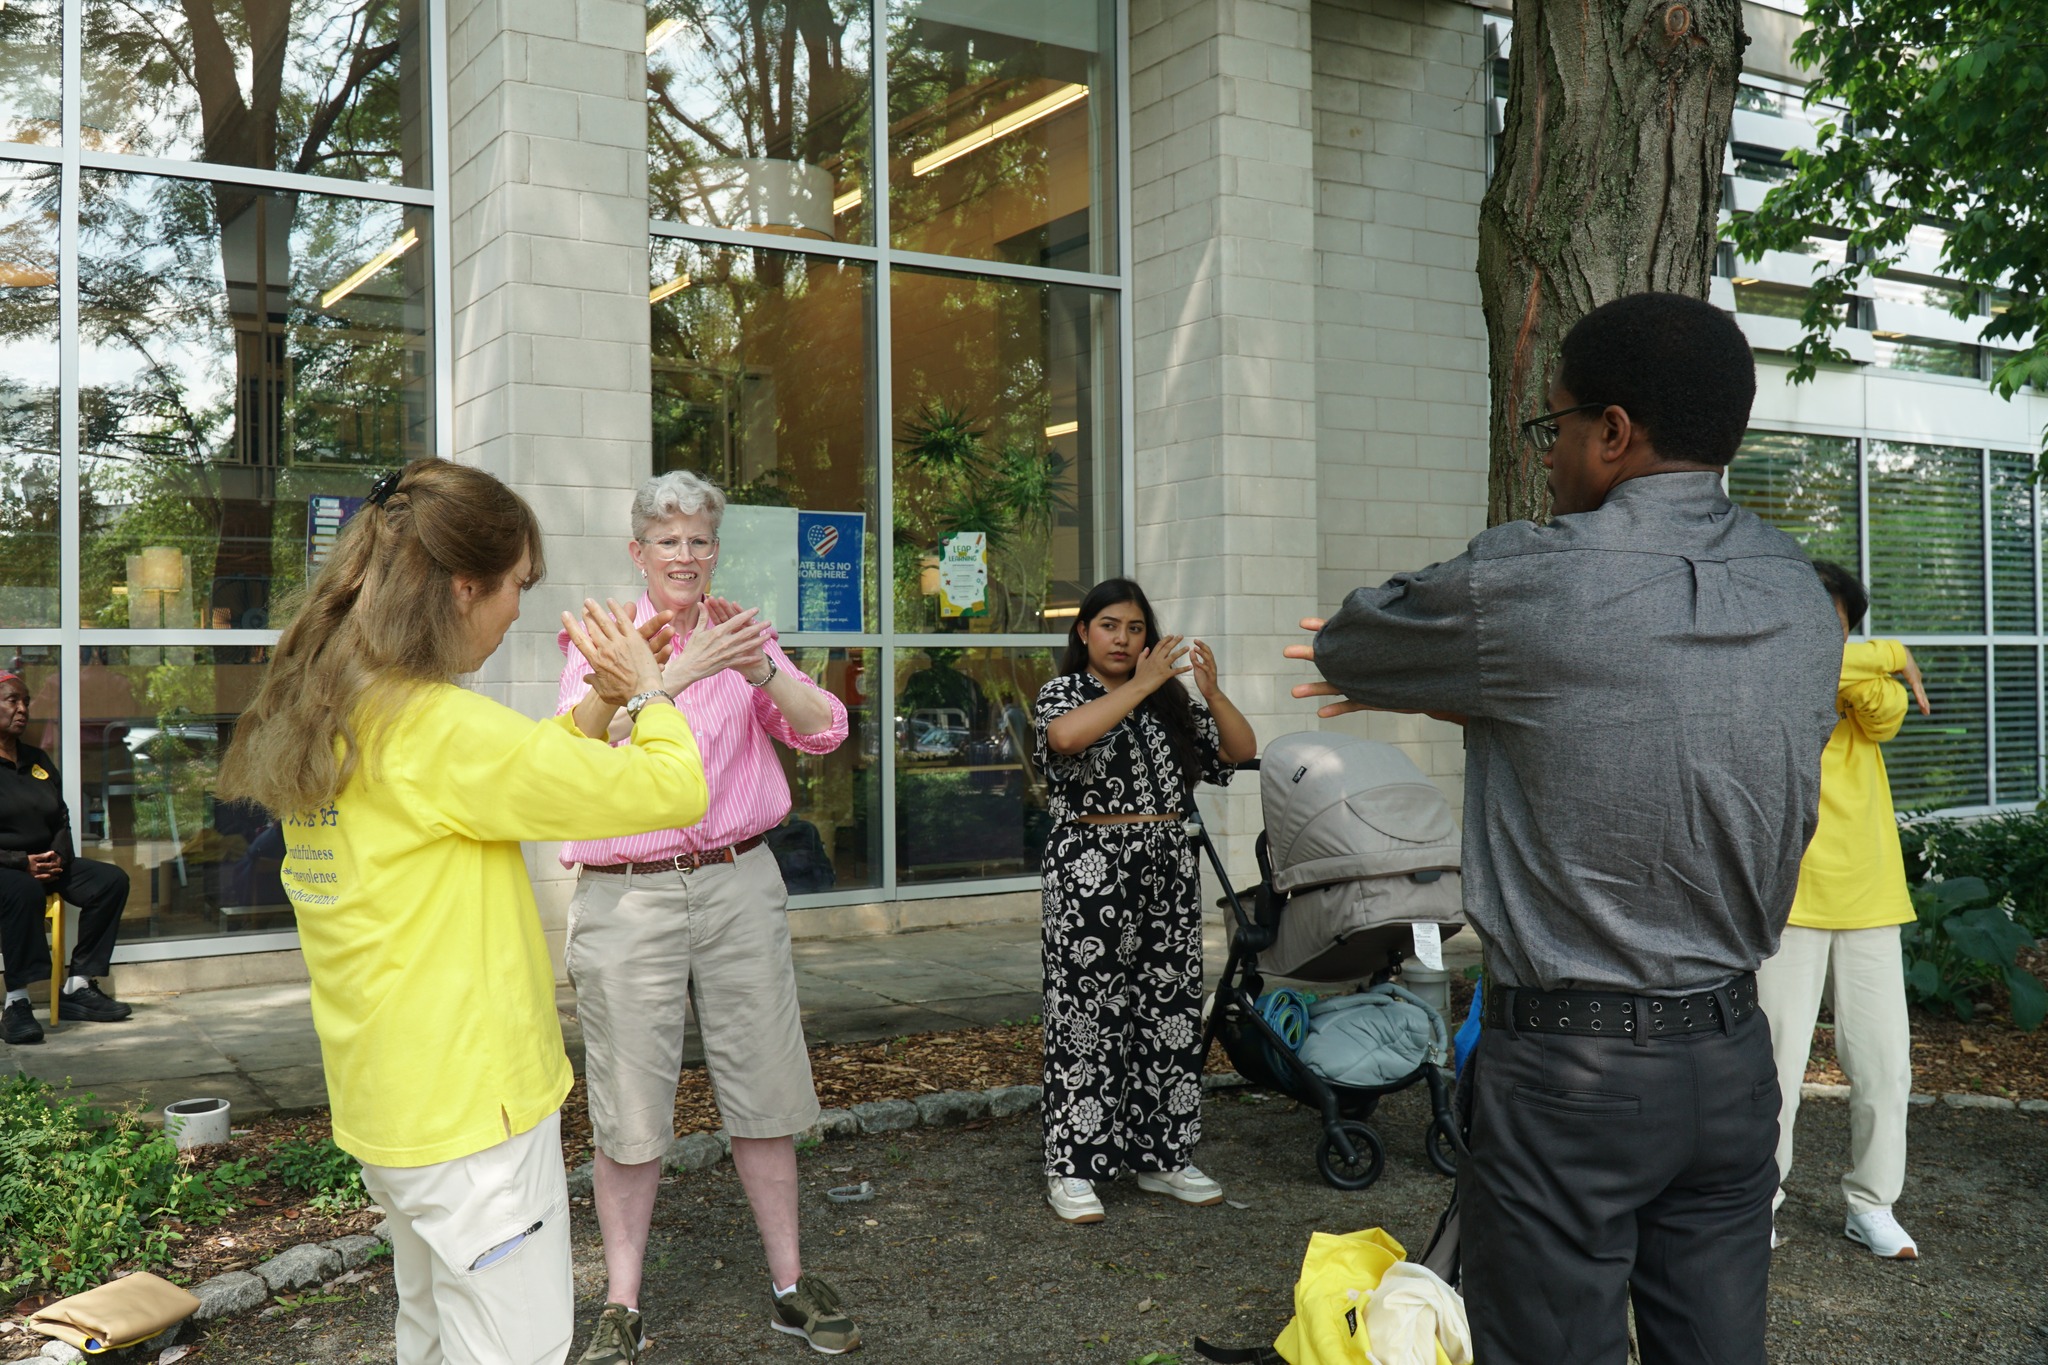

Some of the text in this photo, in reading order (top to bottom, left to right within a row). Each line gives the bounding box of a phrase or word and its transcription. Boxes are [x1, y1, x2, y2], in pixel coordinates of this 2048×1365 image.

[817, 562, 835, 570] HAS
[837, 562, 851, 570] NO
[823, 570, 849, 579] HERE.
